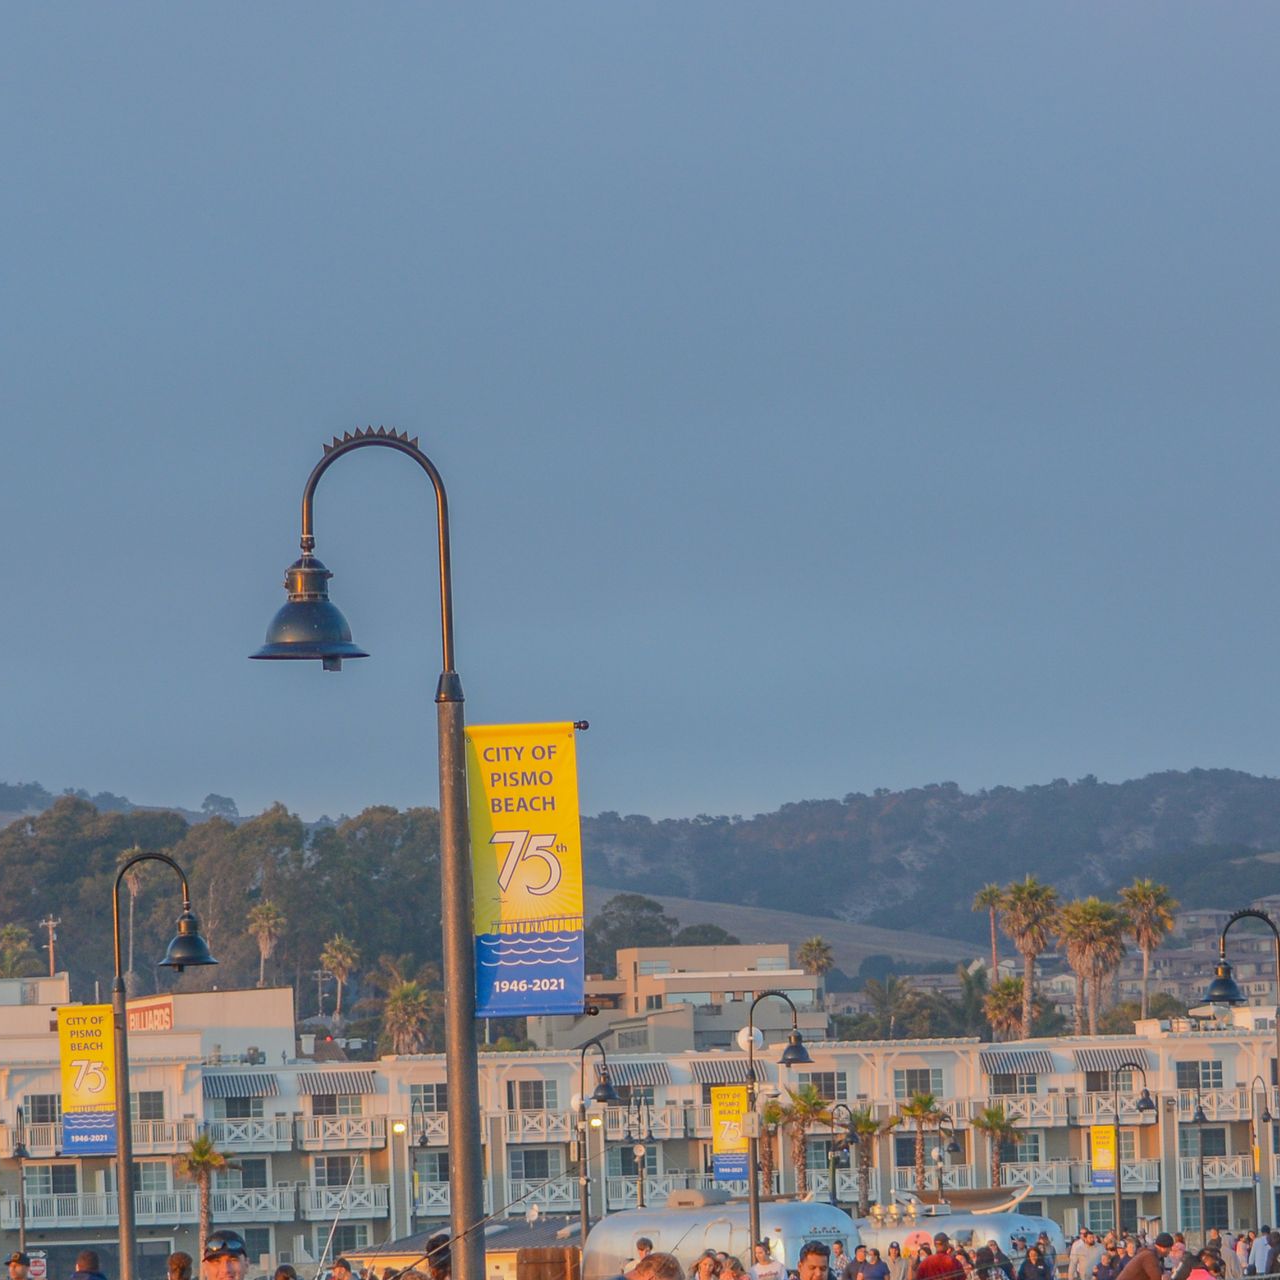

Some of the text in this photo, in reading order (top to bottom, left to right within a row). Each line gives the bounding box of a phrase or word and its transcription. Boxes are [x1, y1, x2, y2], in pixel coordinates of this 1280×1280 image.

[483, 745, 557, 762] CITY OF
[491, 770, 553, 787] PISMO
[491, 796, 555, 813] BEACH
[493, 978, 565, 993] 1946-2021
[66, 1016, 104, 1026] CITY OF
[129, 1008, 170, 1031] BILLIARDS
[70, 1029, 102, 1038] PISMO
[70, 1042, 103, 1051] BEACH
[71, 1134, 108, 1143] 1946-2021
